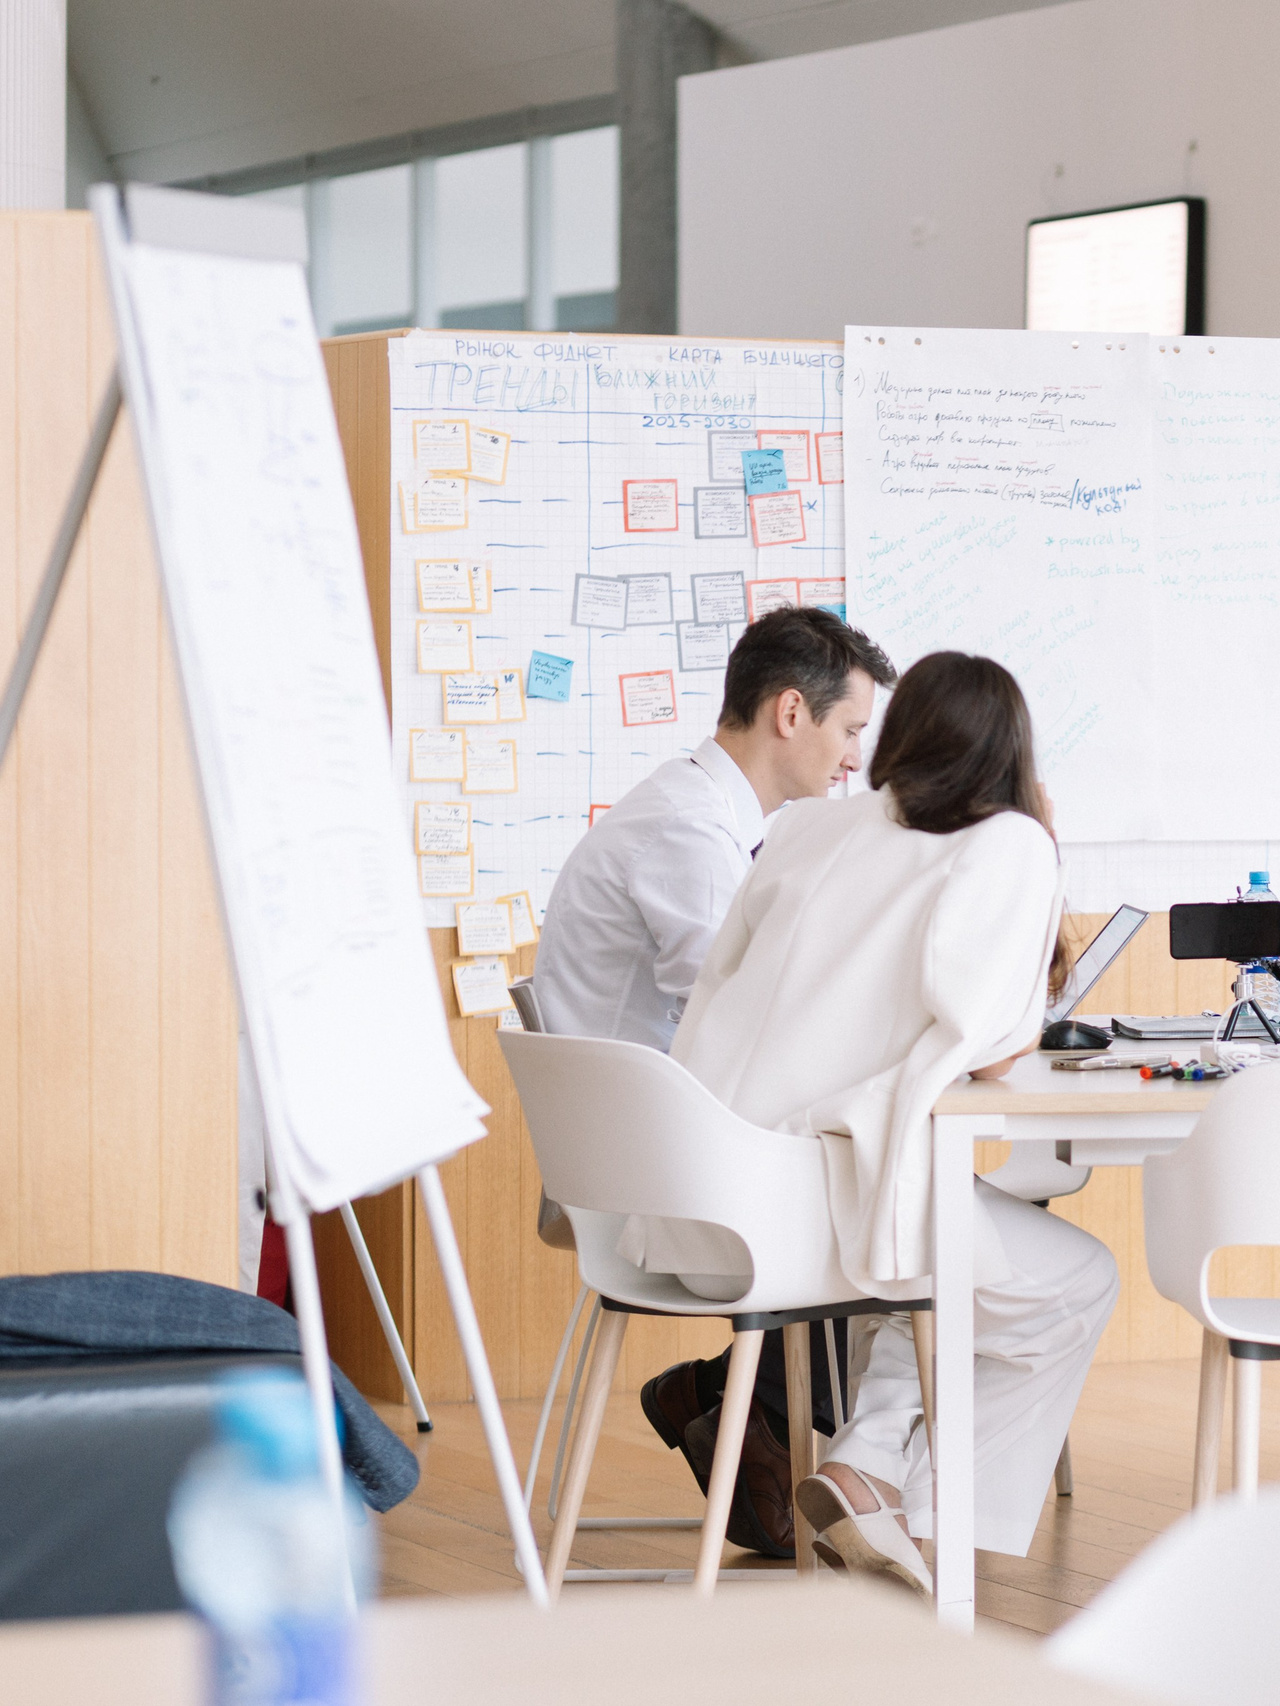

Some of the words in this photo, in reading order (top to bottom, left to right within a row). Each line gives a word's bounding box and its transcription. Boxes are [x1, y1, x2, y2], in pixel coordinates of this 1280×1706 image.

[455, 339, 521, 359] РЫНОК
[669, 346, 723, 364] КАРТА
[414, 360, 578, 412] ТРЕНДЫ
[594, 364, 717, 389] БЛИЖНИЙ
[642, 415, 752, 429] 2025-2030
[1120, 527, 1140, 553] by
